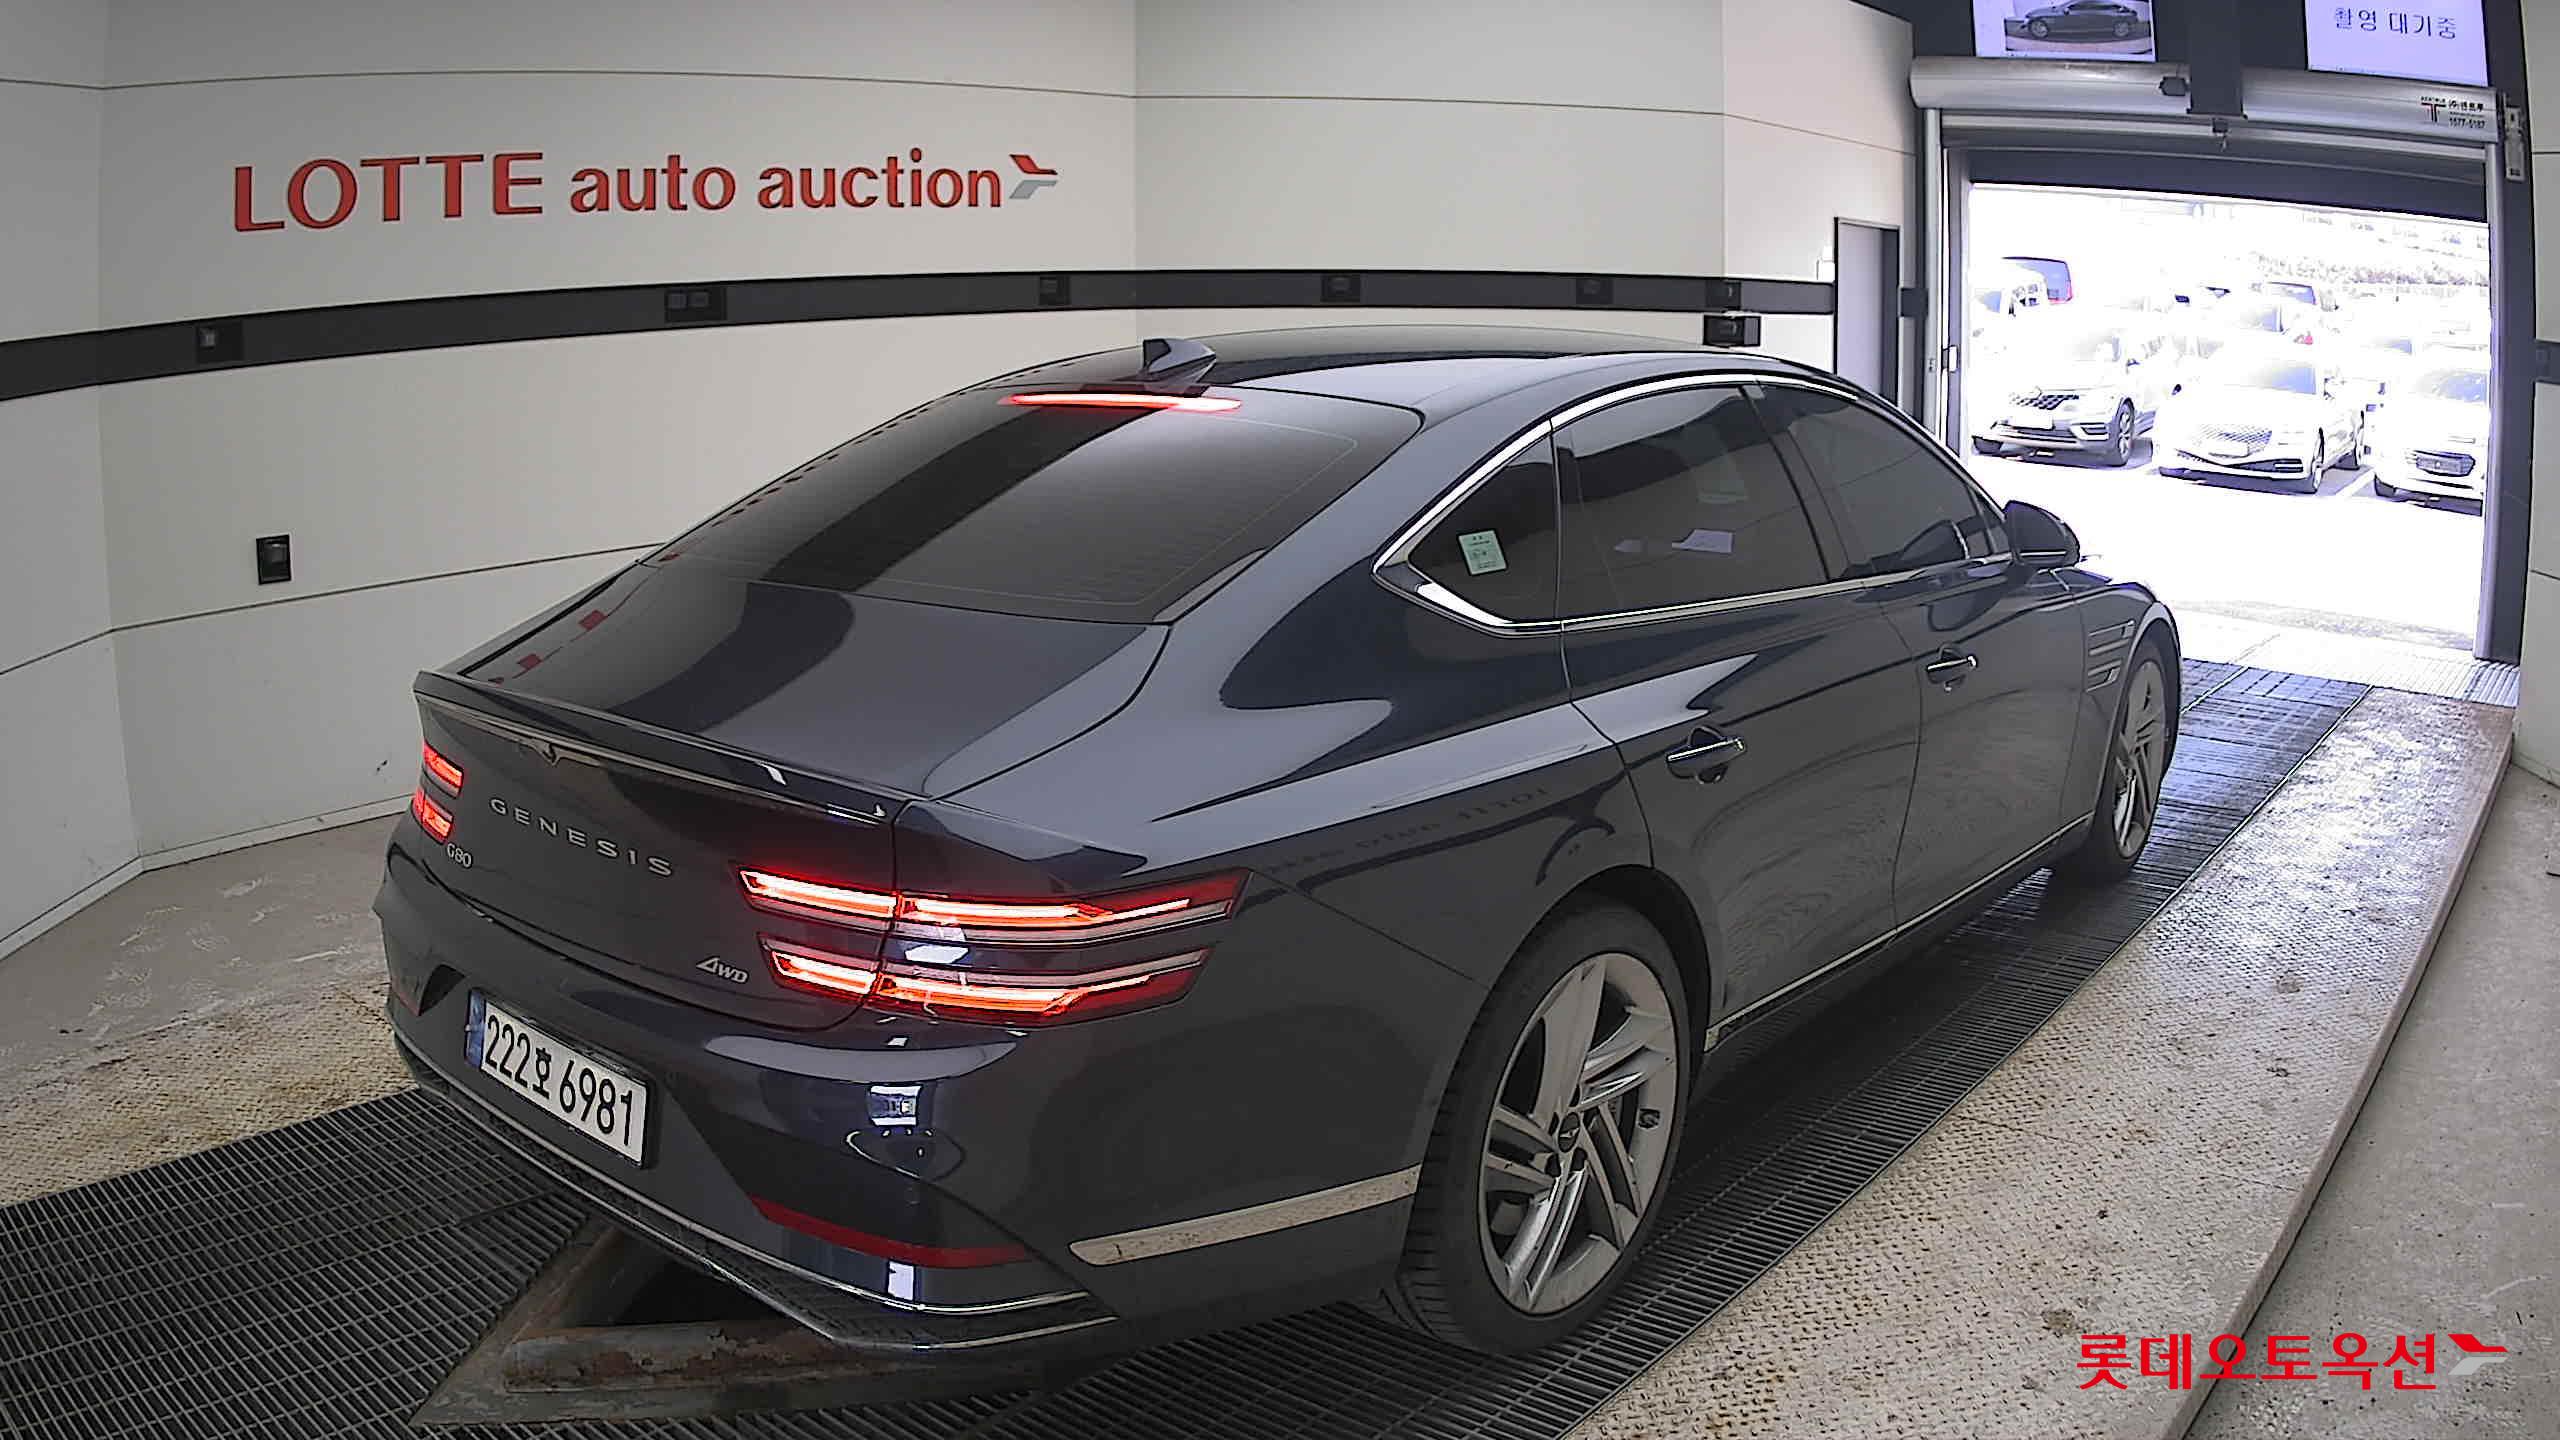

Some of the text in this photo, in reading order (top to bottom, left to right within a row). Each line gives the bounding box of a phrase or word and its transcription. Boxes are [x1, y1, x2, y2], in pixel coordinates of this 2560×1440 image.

[2389, 12, 2456, 39] 대기중
[234, 147, 1002, 232] LOTTE auto auction
[446, 842, 473, 868] G80
[489, 798, 673, 876] GENESIS
[695, 955, 749, 984] AWD
[485, 1014, 634, 1146] 222호 6981
